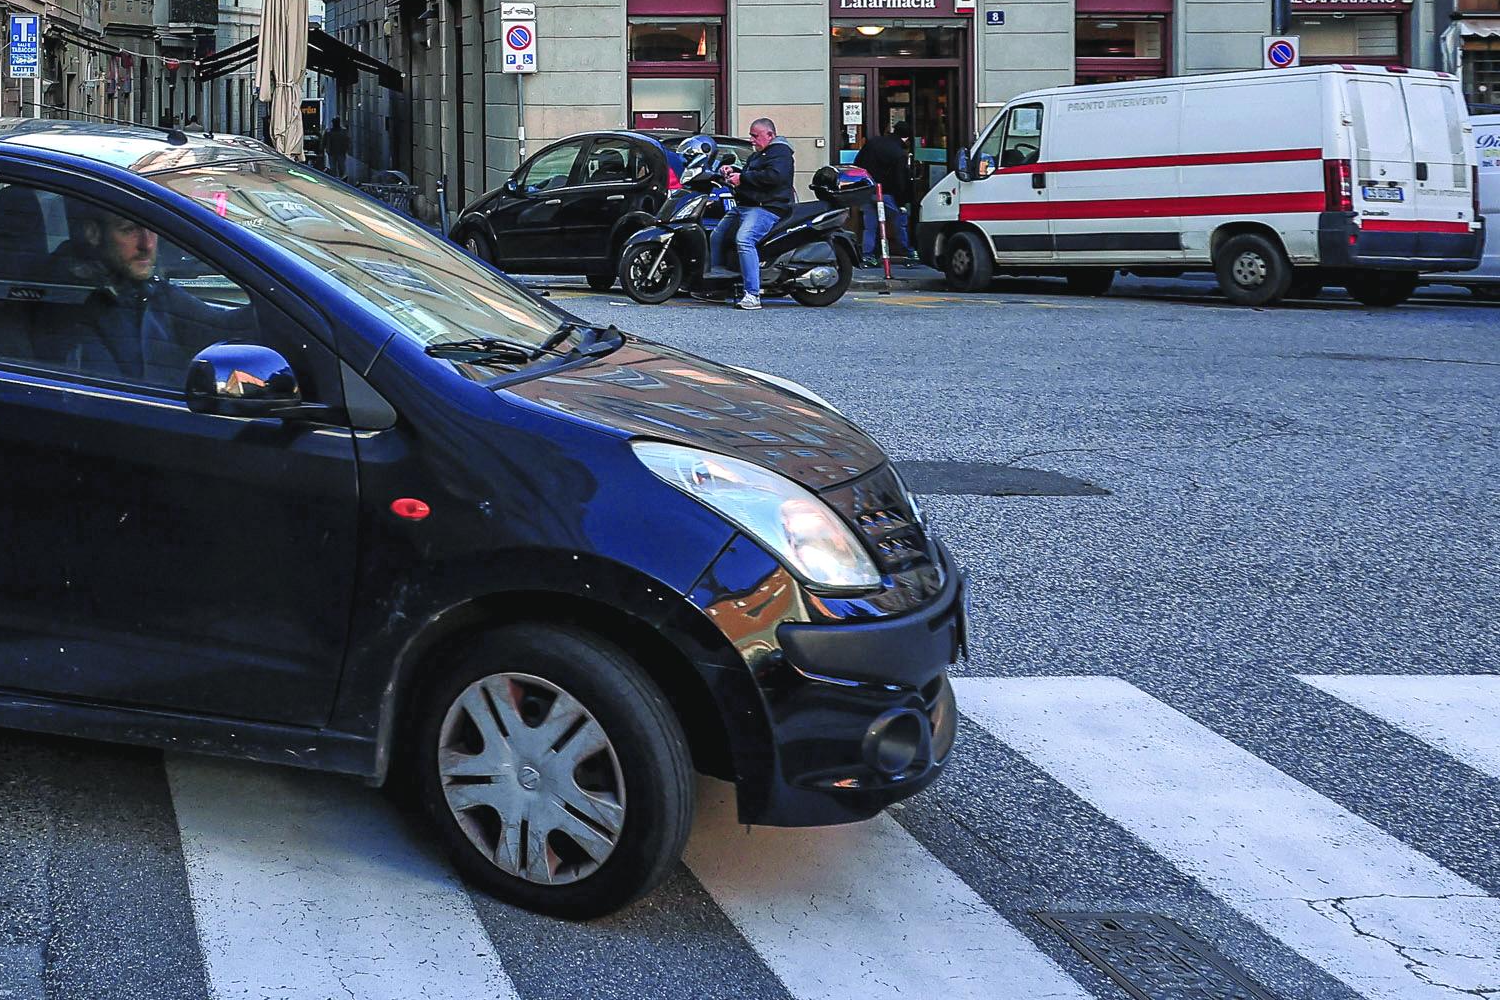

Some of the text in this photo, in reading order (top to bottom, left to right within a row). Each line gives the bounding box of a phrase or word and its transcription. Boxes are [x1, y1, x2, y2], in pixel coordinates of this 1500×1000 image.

[992, 12, 999, 21] 8
[14, 18, 34, 42] T
[507, 55, 515, 64] P
[1067, 95, 1168, 112] PRONTO INTERVENTO
